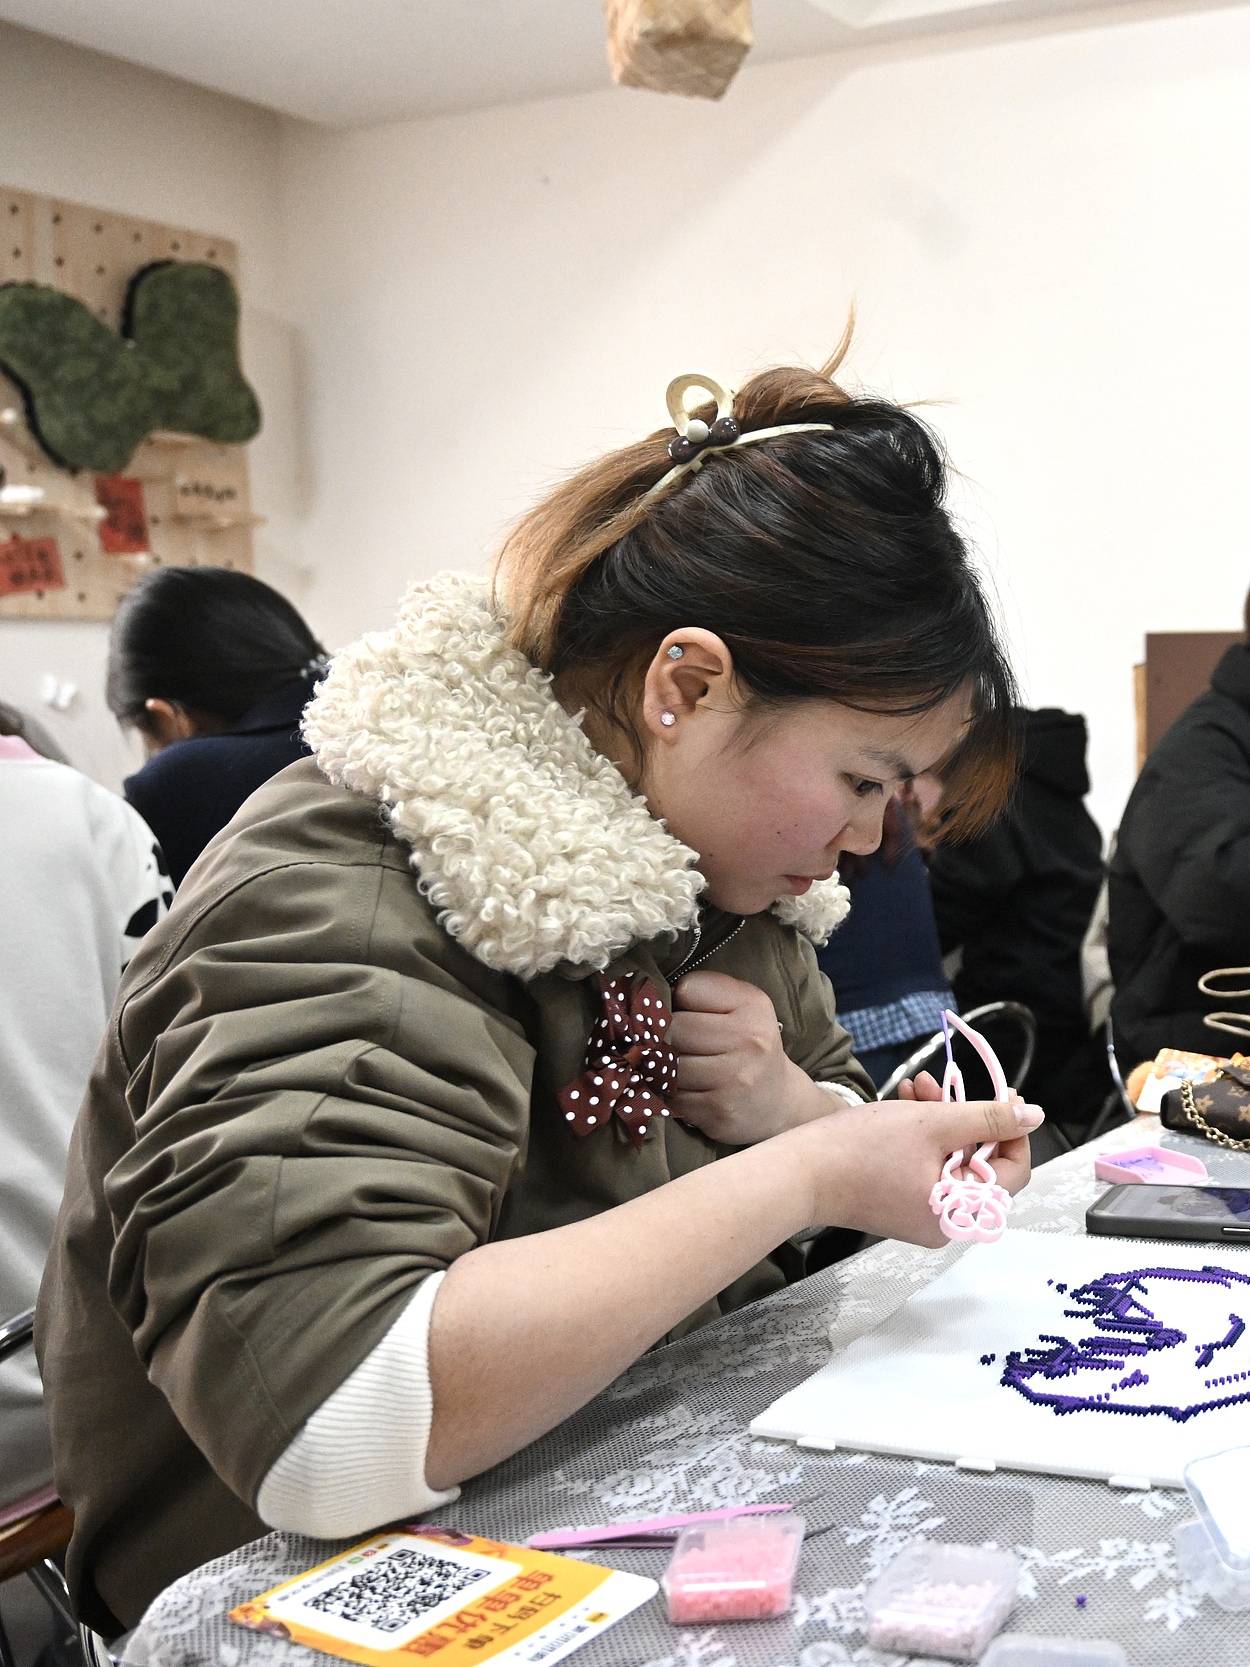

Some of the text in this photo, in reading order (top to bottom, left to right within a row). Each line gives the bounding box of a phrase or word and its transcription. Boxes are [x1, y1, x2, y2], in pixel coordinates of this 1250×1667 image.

[399, 1569, 556, 1658] 单单优惠
[463, 1592, 562, 1650] 扫码下单
